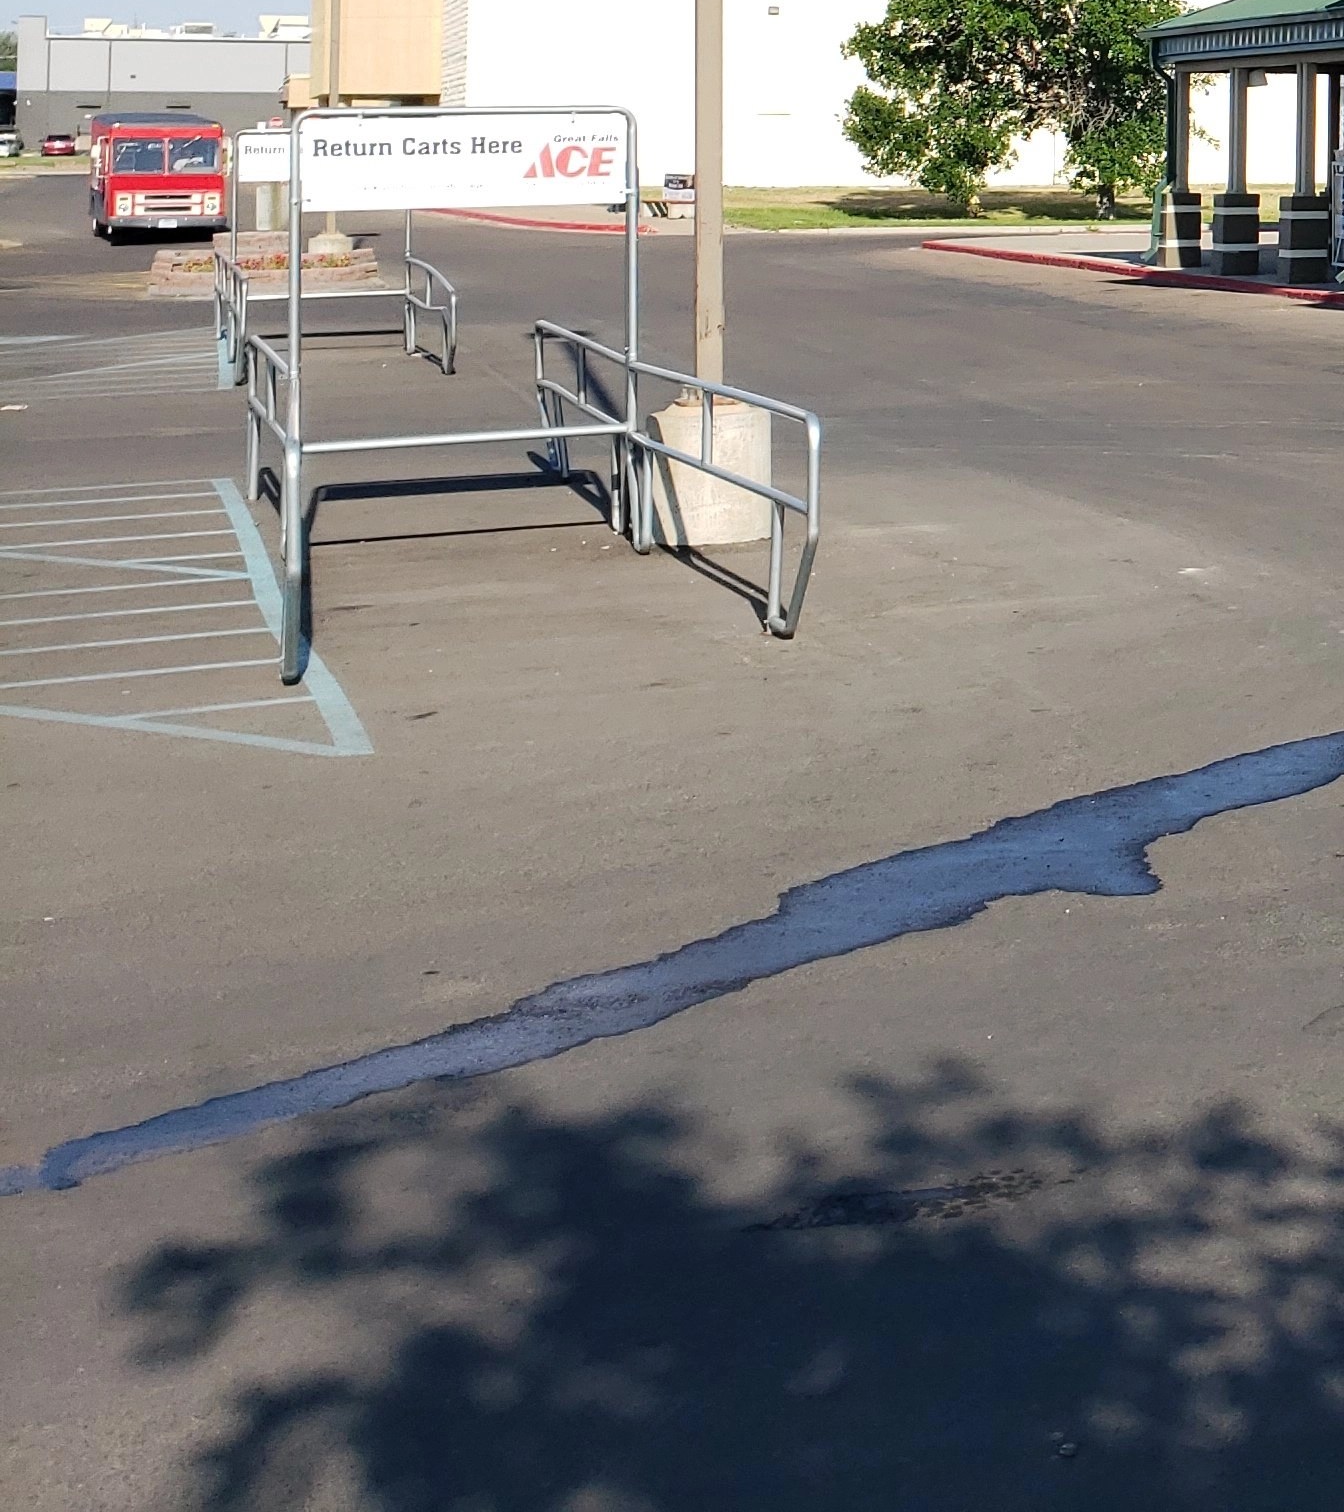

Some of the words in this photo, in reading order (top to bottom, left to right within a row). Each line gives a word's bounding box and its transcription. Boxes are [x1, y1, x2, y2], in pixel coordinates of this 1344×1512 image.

[244, 145, 285, 155] Return
[312, 138, 392, 157] Return
[402, 137, 461, 155] Carts
[470, 136, 522, 154] Here
[522, 143, 616, 178] ACE
